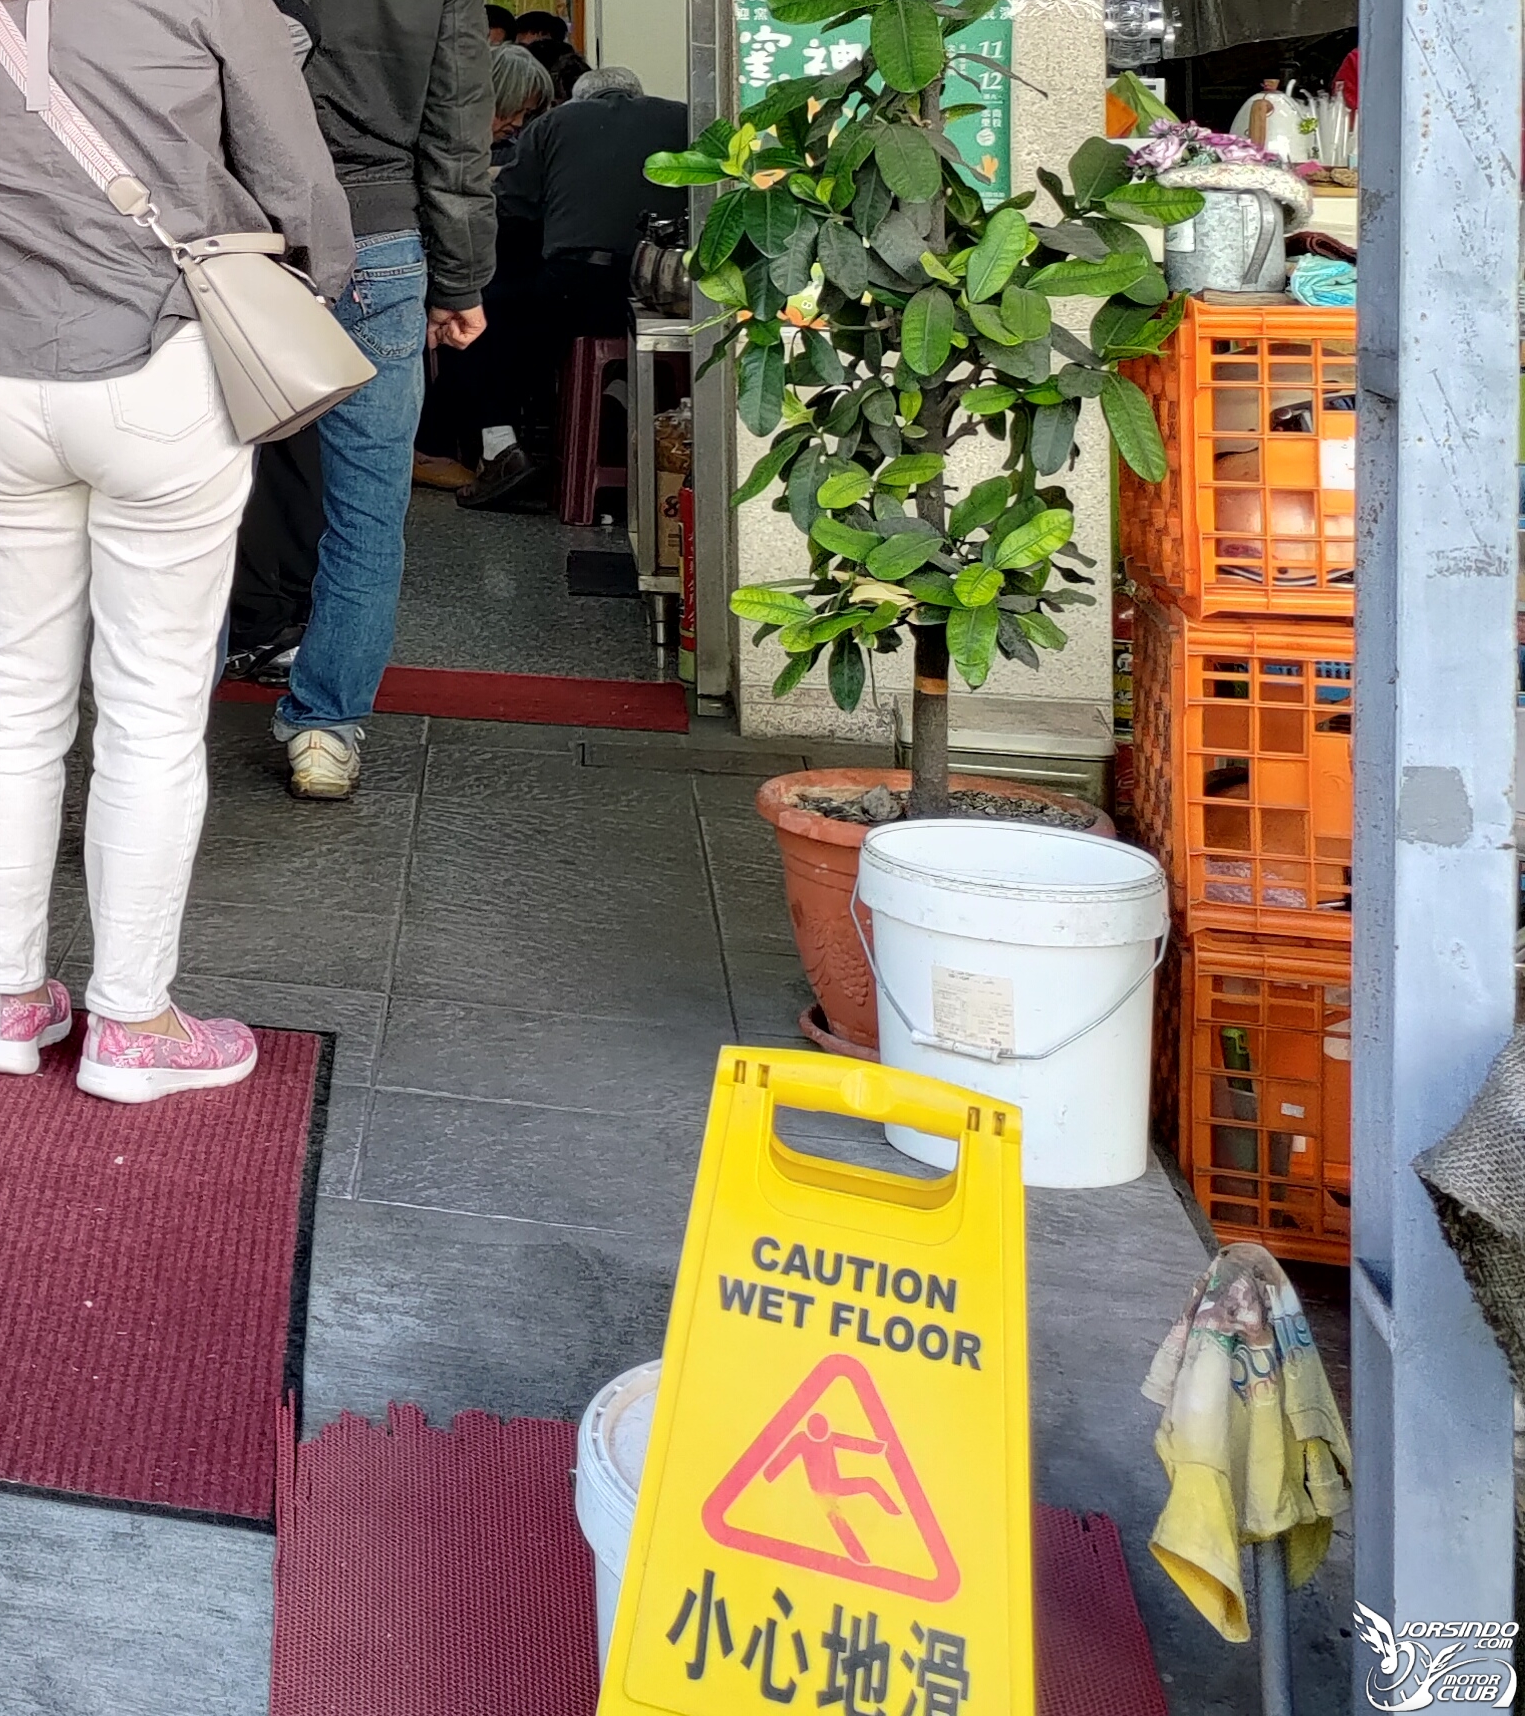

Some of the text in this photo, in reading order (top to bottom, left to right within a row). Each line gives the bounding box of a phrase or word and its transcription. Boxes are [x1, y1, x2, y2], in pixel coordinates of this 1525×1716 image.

[718, 1274, 982, 1371] WET FLOOR
[751, 1236, 957, 1313] CAUTION
[665, 1568, 971, 1716] 小心地滑
